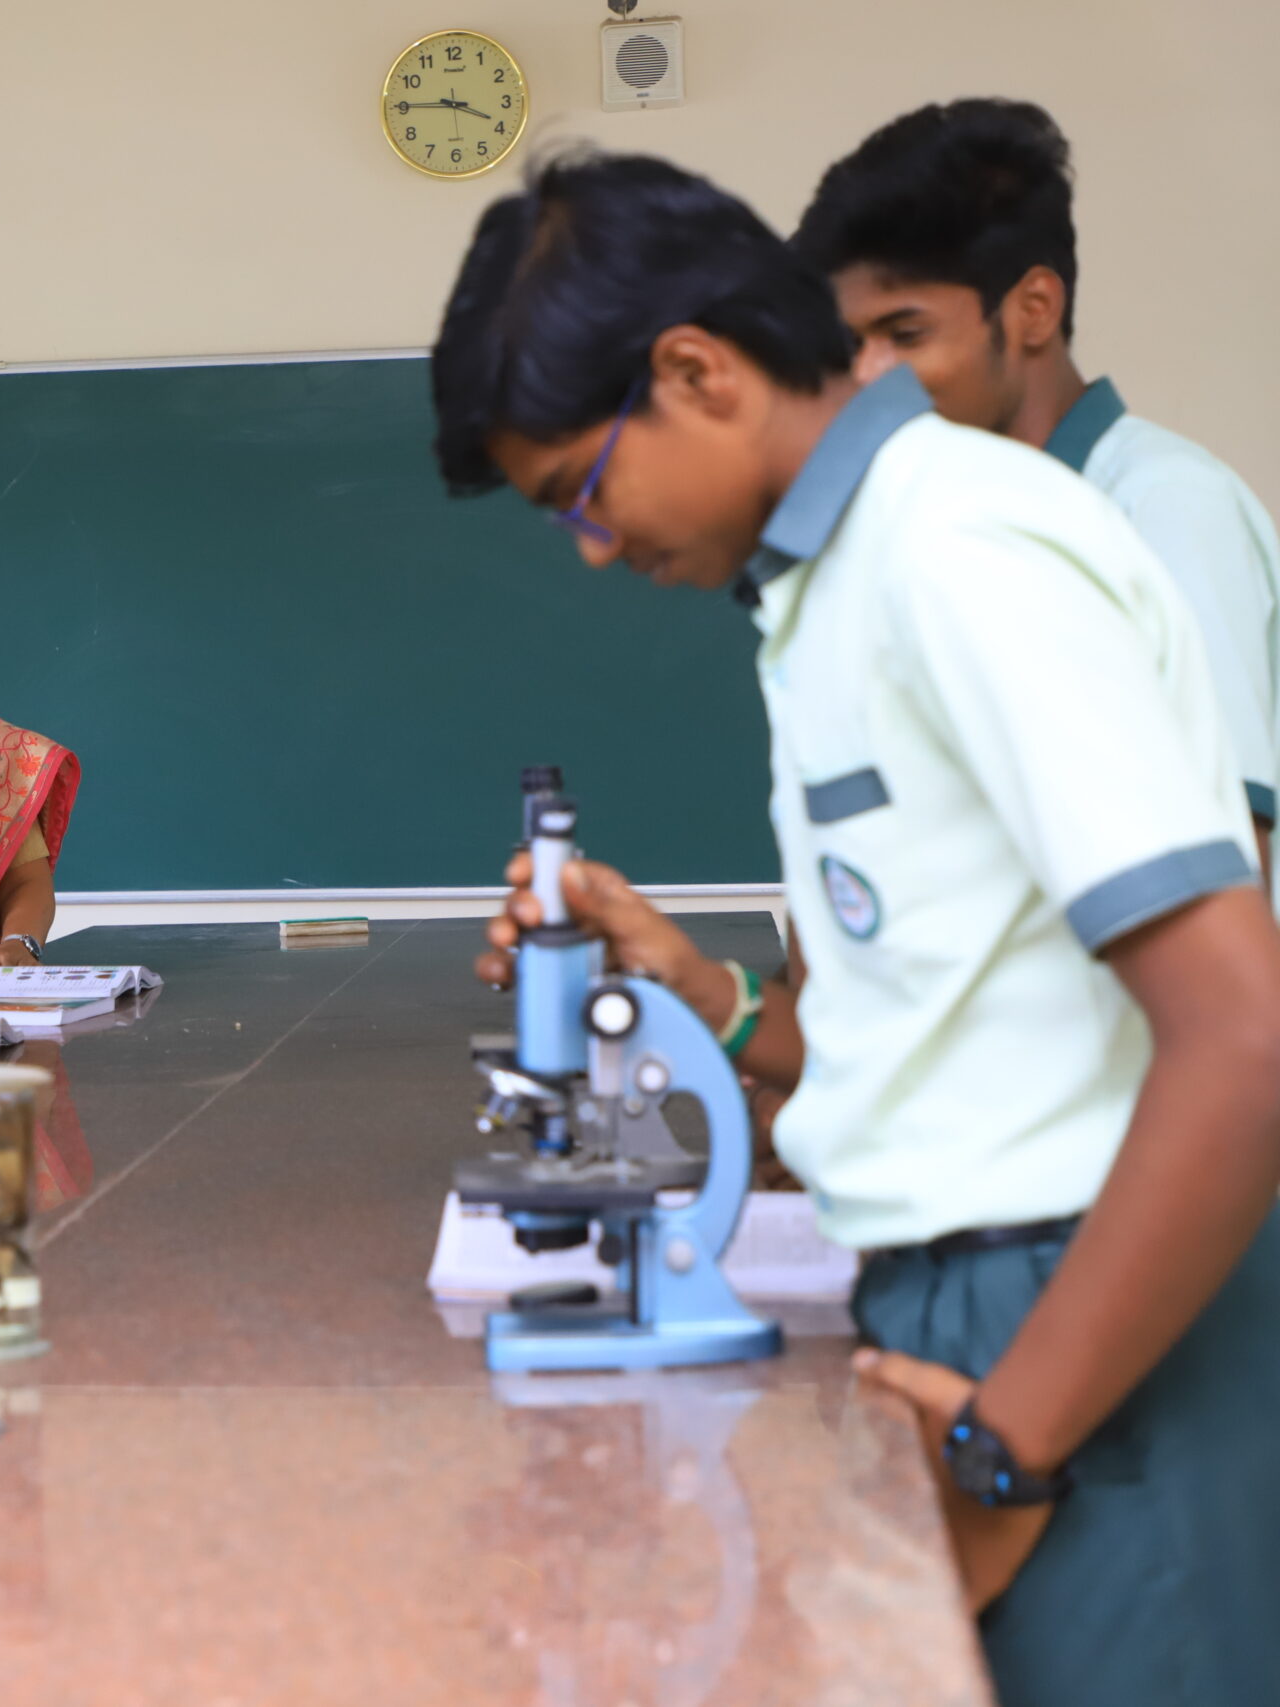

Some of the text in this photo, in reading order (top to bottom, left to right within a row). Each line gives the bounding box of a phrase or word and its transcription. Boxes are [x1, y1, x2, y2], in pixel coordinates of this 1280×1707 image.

[445, 46, 462, 61] 12
[476, 51, 483, 65] 1
[419, 55, 433, 69] 11
[402, 74, 421, 89] 10
[494, 68, 504, 83] 2
[398, 101, 409, 115] 9
[501, 94, 511, 109] 3
[406, 126, 416, 141] 8
[494, 121, 505, 135] 4
[425, 144, 435, 158] 7
[451, 148, 462, 163] 6
[477, 141, 488, 156] 5
